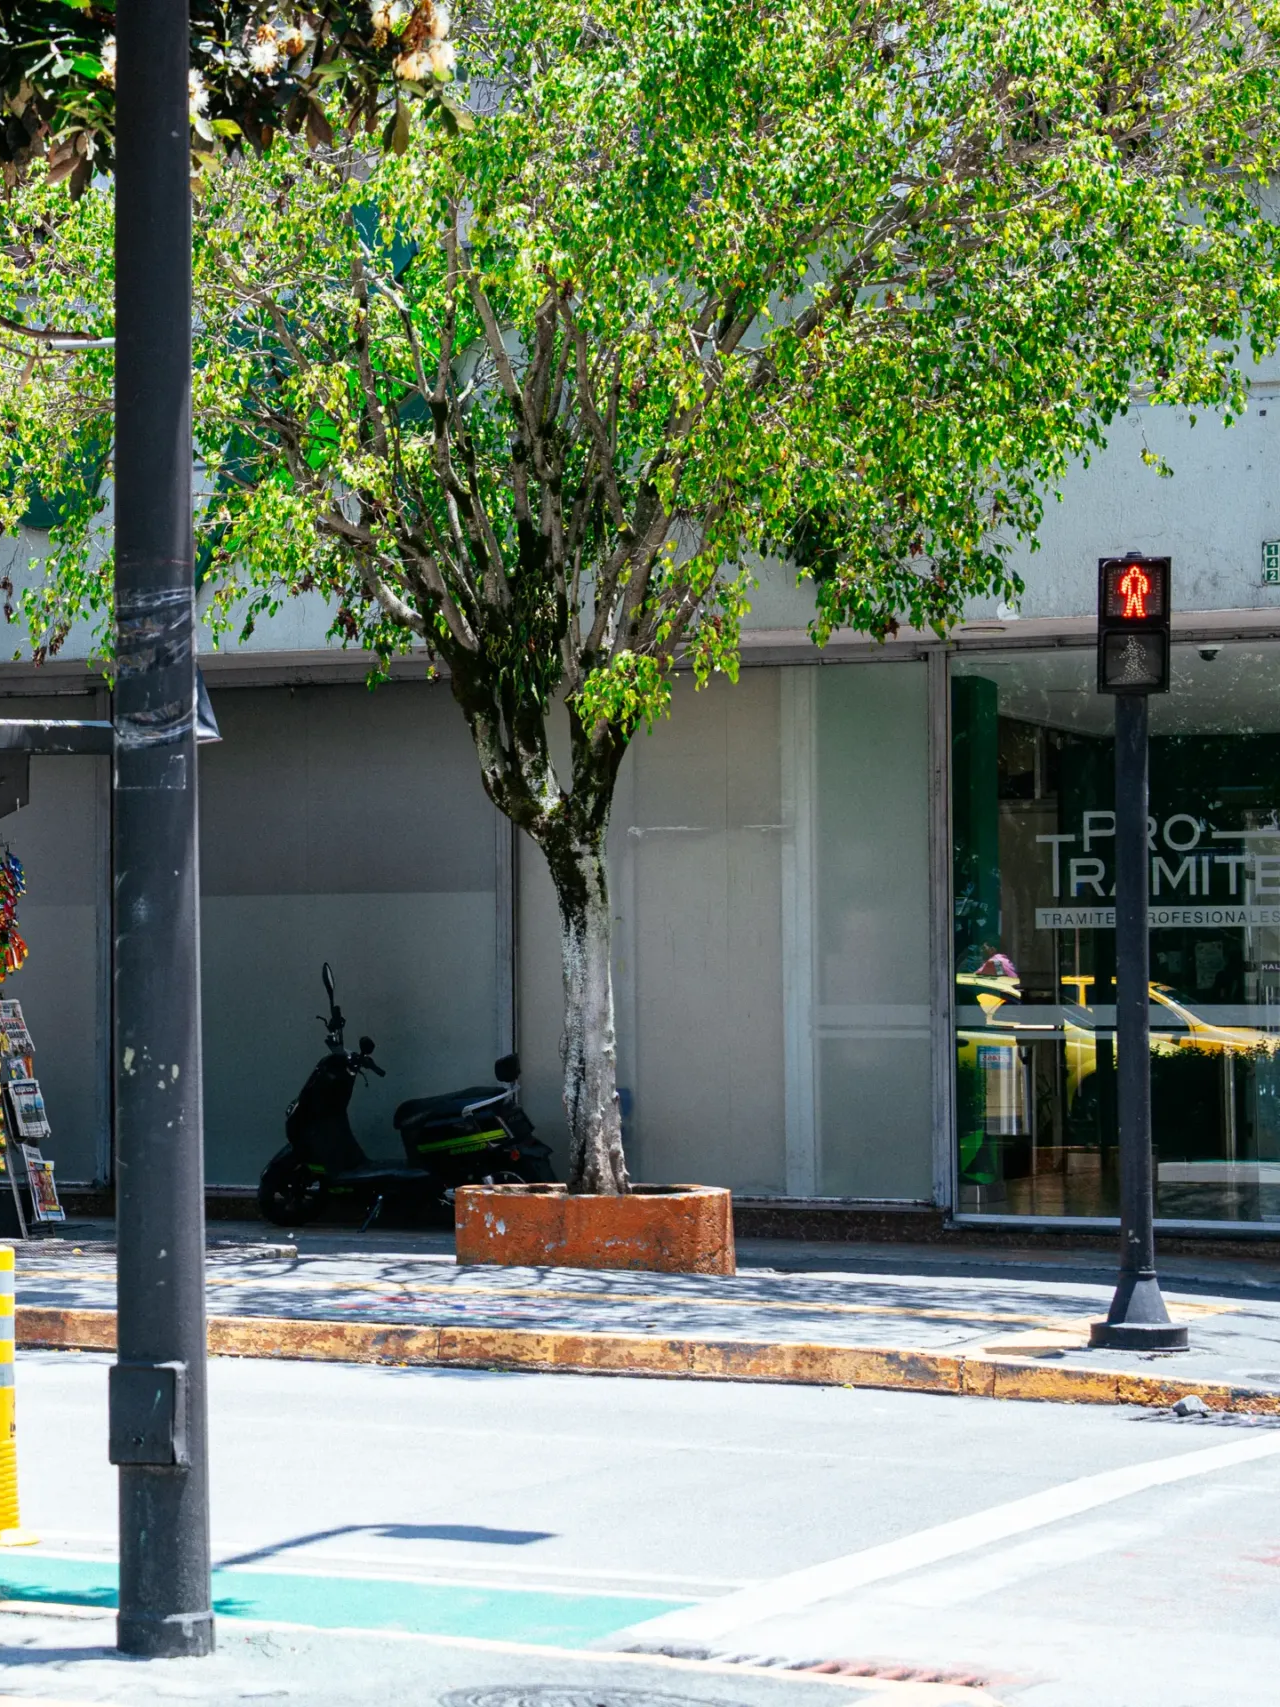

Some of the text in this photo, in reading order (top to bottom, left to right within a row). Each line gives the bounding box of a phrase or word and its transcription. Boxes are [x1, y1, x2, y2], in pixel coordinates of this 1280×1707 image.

[1036, 833, 1280, 897] TRMITE
[1042, 911, 1280, 925] TRAMITE ROFESIONALES
